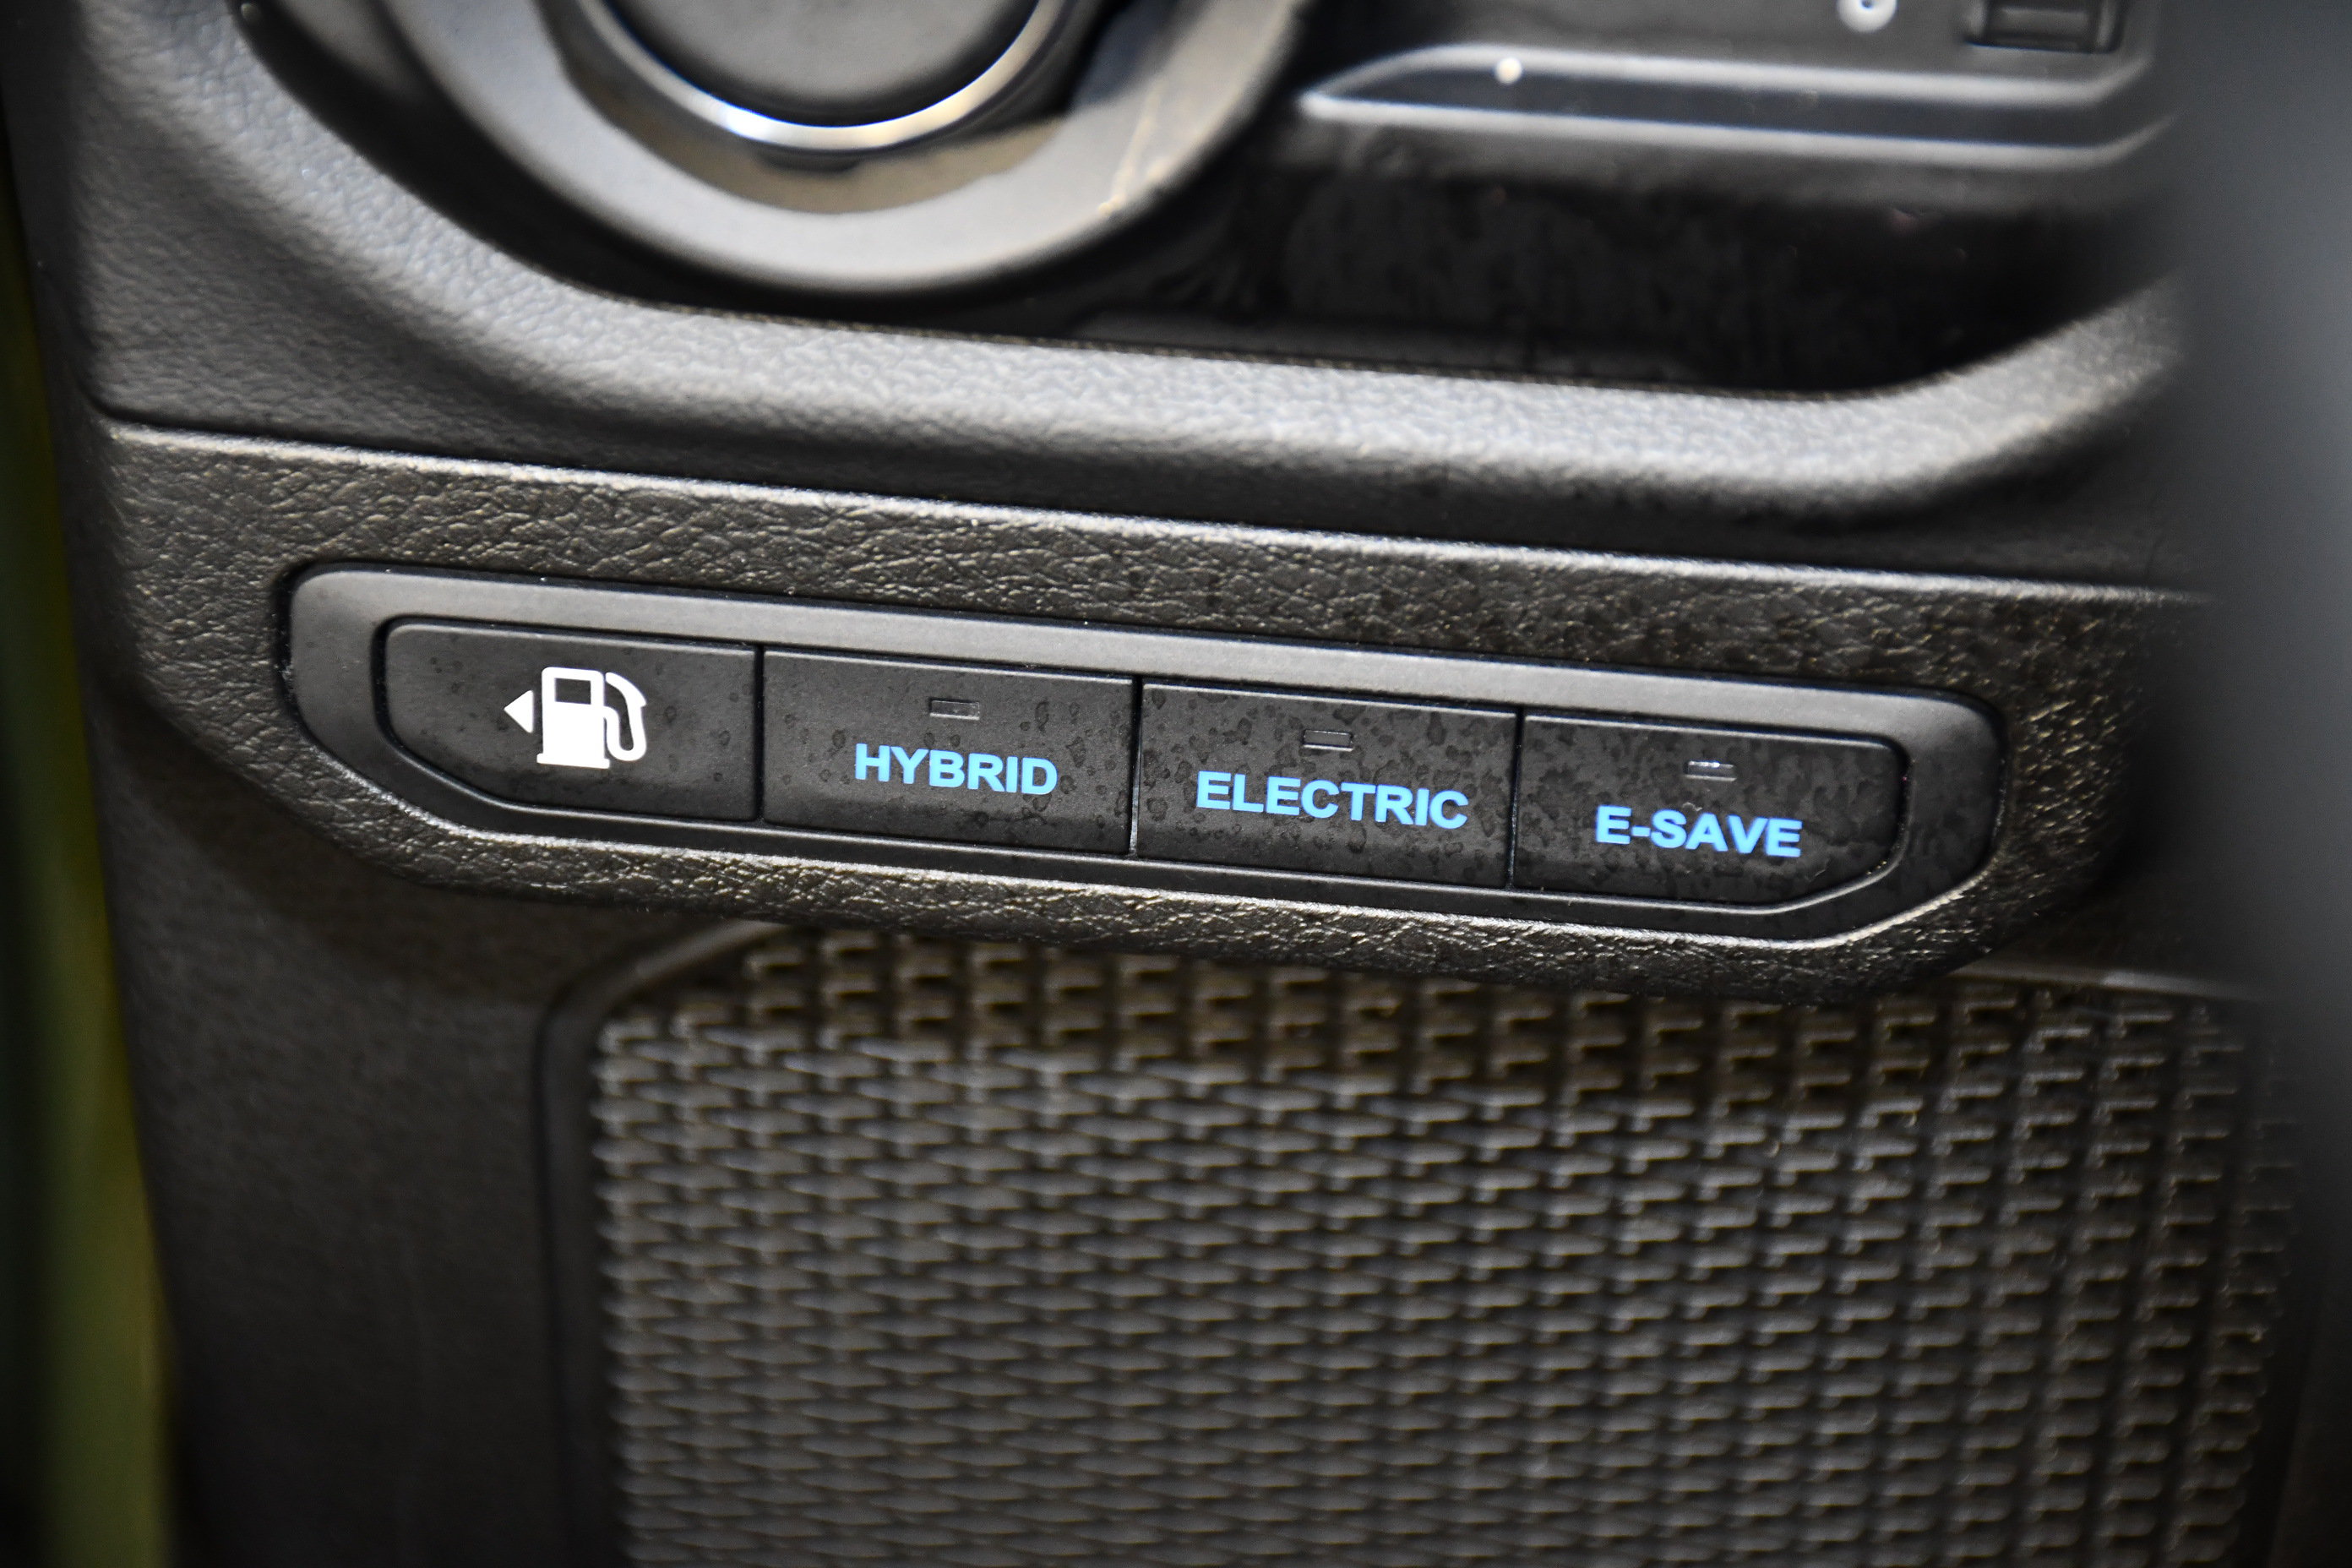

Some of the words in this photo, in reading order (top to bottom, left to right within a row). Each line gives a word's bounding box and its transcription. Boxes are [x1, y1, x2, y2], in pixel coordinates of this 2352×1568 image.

[853, 742, 1059, 795] HYBRID
[1195, 770, 1469, 830] ELECTRIC
[1594, 804, 1804, 858] E-SAVE
